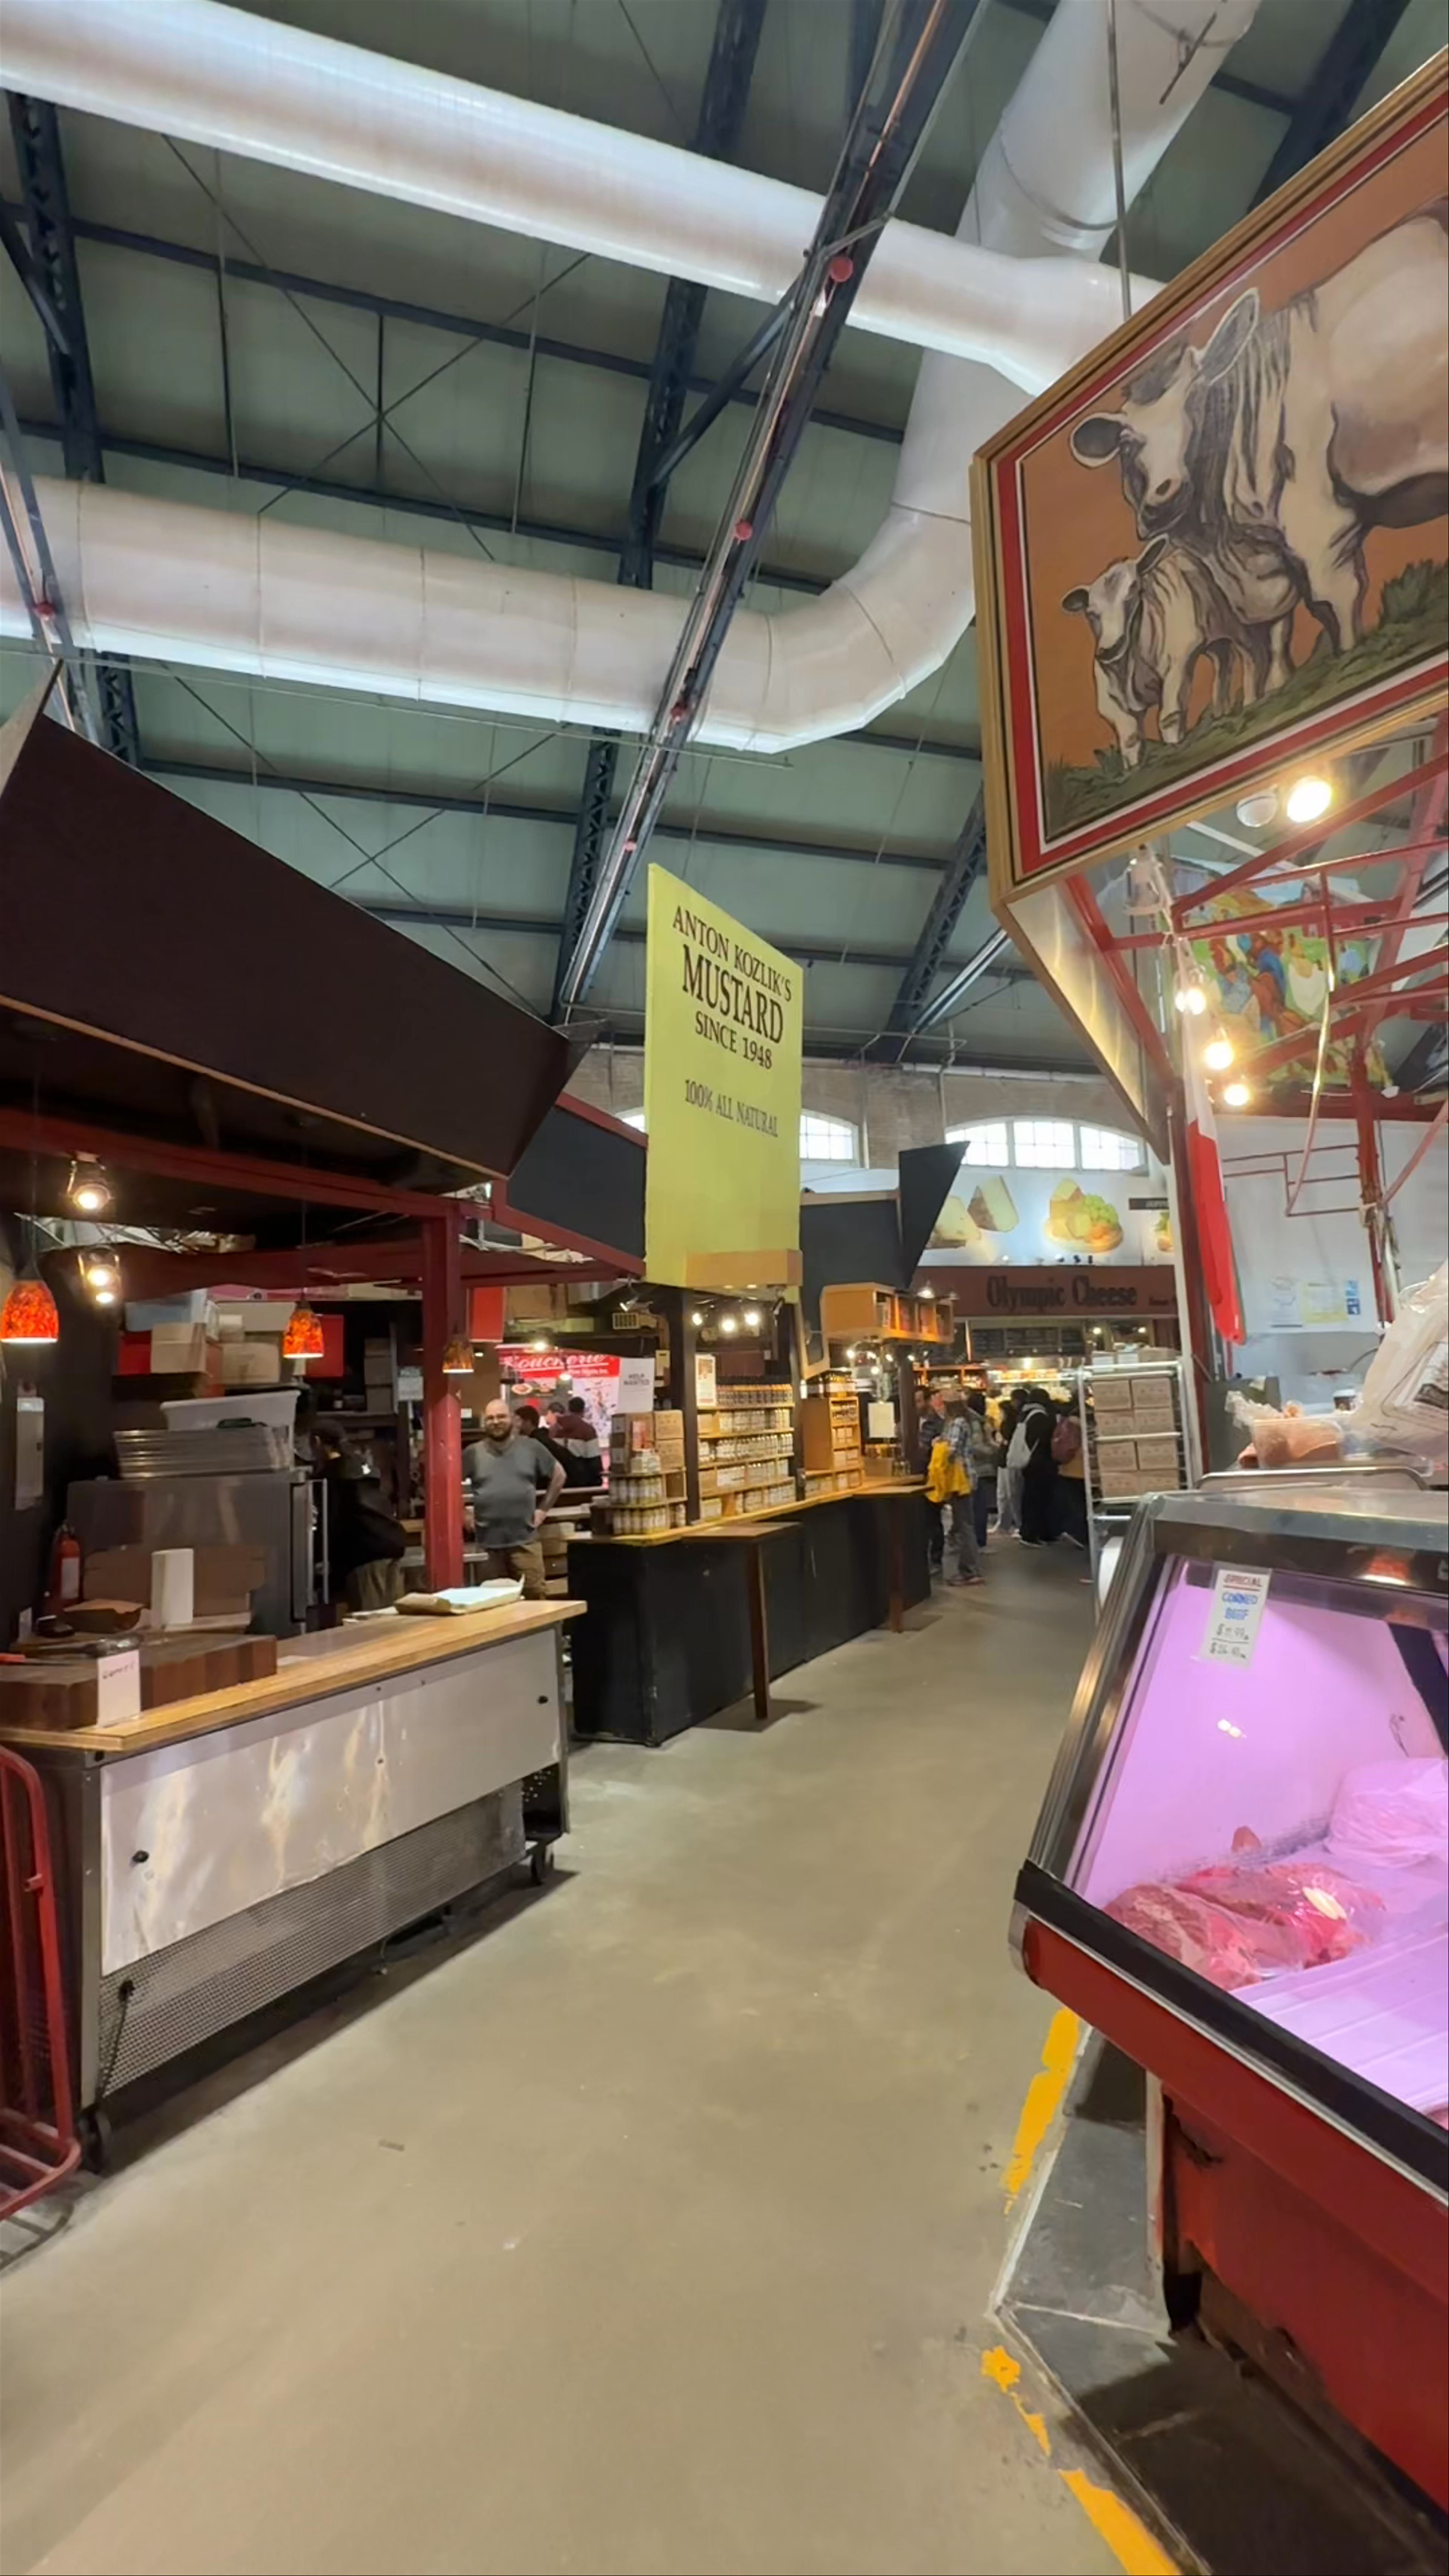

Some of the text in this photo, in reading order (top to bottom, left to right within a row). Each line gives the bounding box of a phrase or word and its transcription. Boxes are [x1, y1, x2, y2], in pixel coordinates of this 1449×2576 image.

[673, 906, 792, 1002] ANTON KOZLIK'S
[682, 944, 783, 1044] MUSTARD
[695, 1011, 772, 1070] SINCE 1948
[685, 1079, 778, 1137] 100% ALL NATURAL
[986, 1275, 1138, 1312] Olympic Cheese
